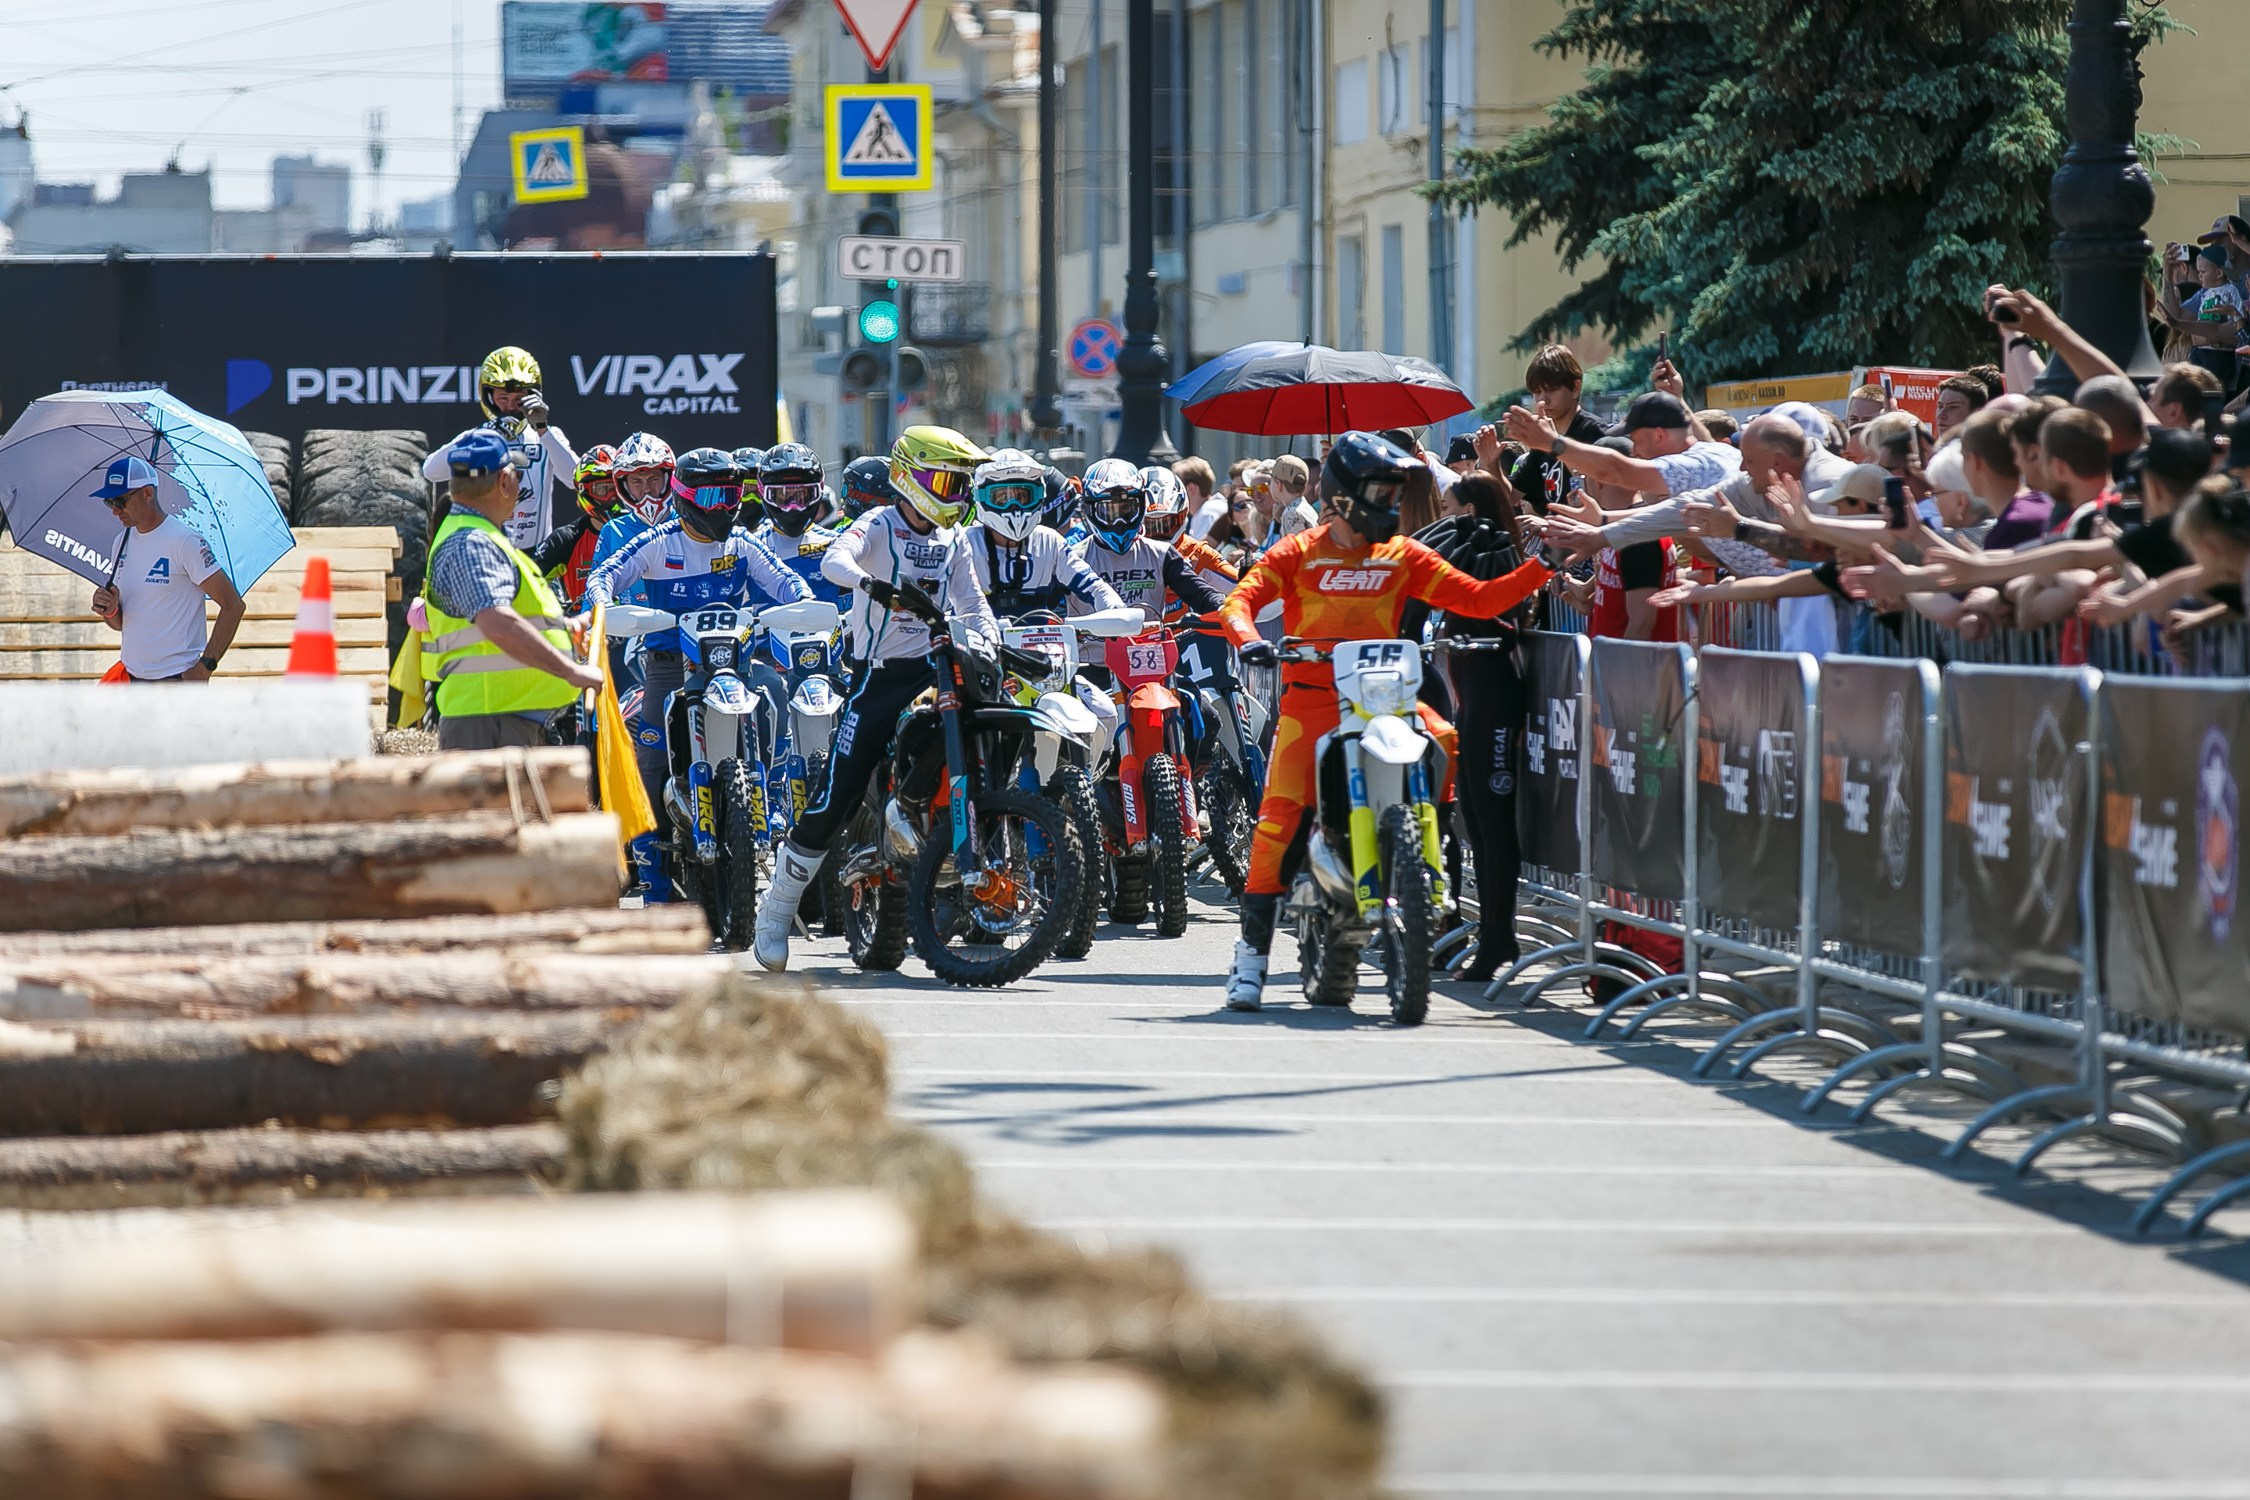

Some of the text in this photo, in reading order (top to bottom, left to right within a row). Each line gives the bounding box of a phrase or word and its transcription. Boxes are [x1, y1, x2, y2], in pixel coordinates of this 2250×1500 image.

[851, 241, 953, 276] СТОП
[570, 353, 746, 396] VIRAX
[643, 396, 741, 415] CAPITAL
[906, 542, 947, 561] 888
[914, 559, 939, 569] TEAM
[1099, 568, 1156, 583] AREX
[1319, 569, 1393, 591] LEATT
[1120, 589, 1143, 603] EAM
[696, 612, 738, 632] 89
[739, 625, 754, 645] DRC
[829, 625, 843, 648] DRC
[709, 651, 733, 663] DRC
[799, 652, 821, 665] DRC
[1130, 650, 1157, 670] 58
[1181, 643, 1214, 683] 1
[1357, 643, 1403, 669] 56
[838, 711, 860, 756] 888
[1494, 727, 1507, 769] SEGAL
[697, 786, 716, 837] DRC
[1122, 782, 1138, 825] 6DAYS
